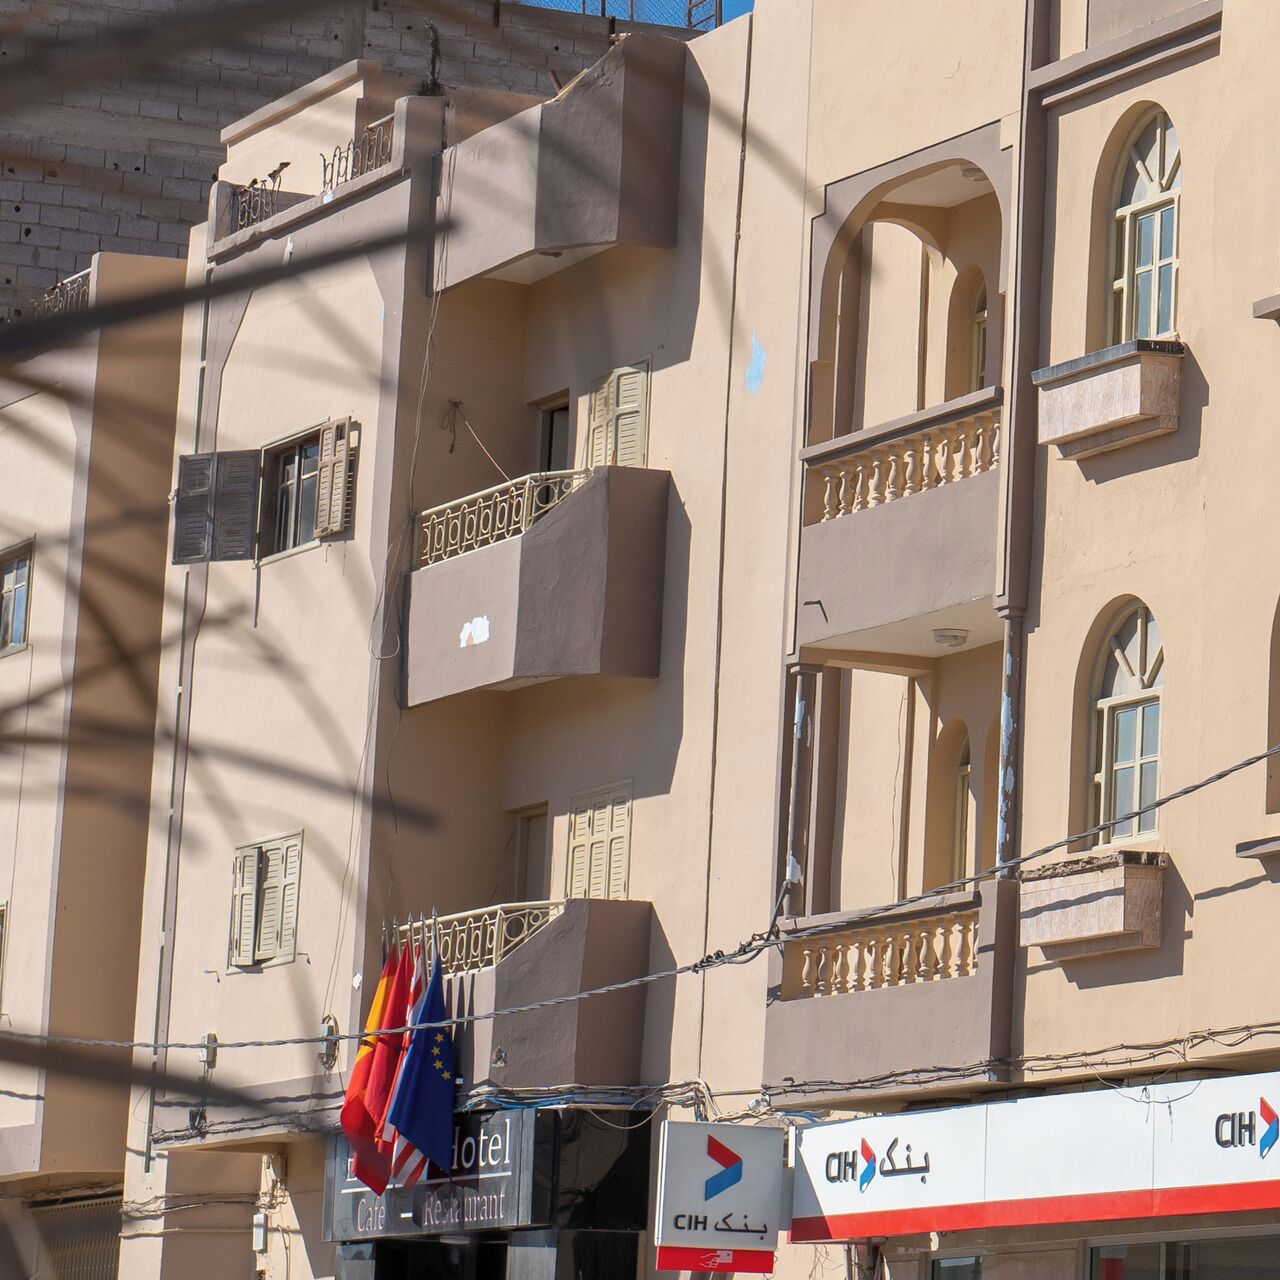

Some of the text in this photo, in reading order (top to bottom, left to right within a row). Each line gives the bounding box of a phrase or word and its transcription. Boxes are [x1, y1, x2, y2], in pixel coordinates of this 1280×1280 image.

[1214, 1110, 1257, 1148] CIH
[825, 1150, 857, 1183] CIH
[423, 1189, 506, 1226] Restaurant
[673, 1214, 707, 1231] CIH
